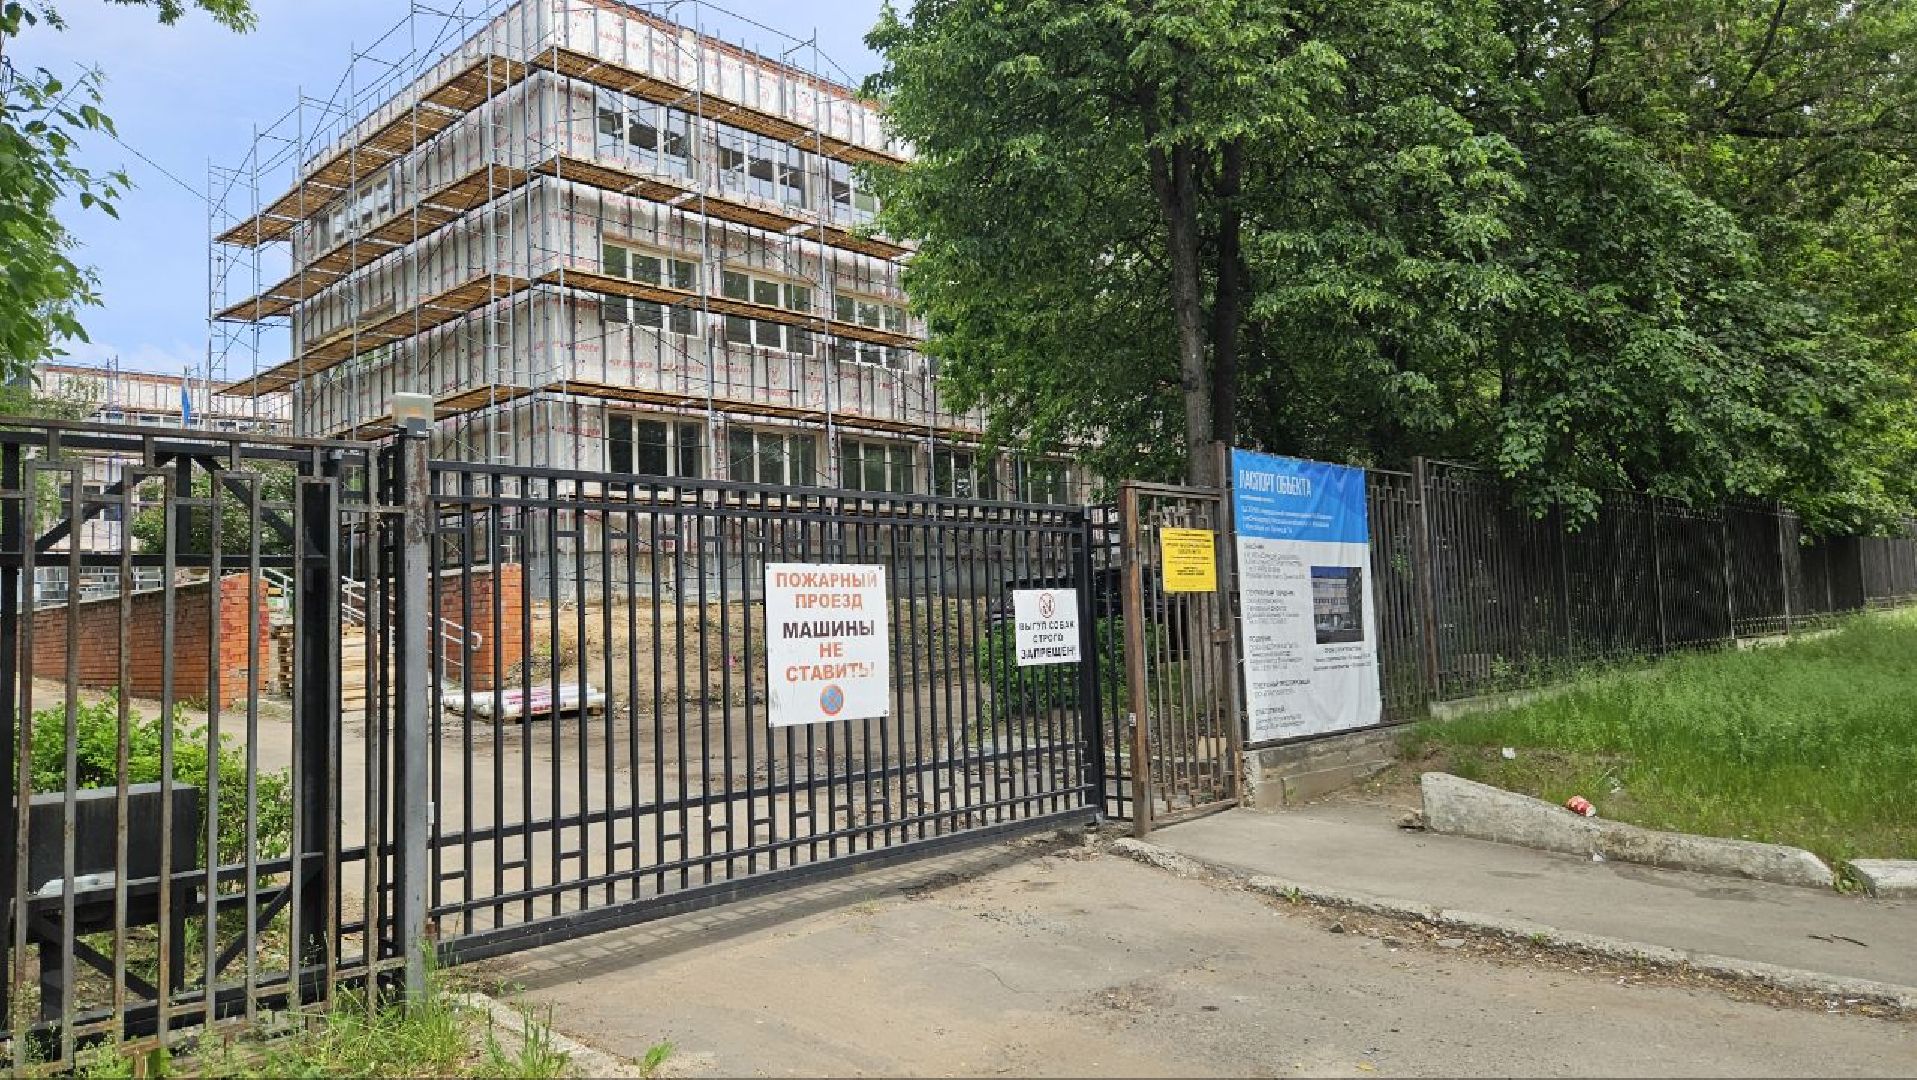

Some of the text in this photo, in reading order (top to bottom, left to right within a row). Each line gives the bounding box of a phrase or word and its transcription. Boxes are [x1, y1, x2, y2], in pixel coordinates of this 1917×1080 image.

[776, 571, 877, 588] ПОЖАРНЫЙ
[795, 593, 863, 610] ПРОЕЗД
[782, 620, 875, 639] МАШИНЫ
[1019, 620, 1075, 631] ВЫГУЛ СОБАК
[1032, 633, 1064, 643] СТРОГО
[819, 642, 844, 658] НЕ
[785, 661, 875, 682] СТАВИТЬ!
